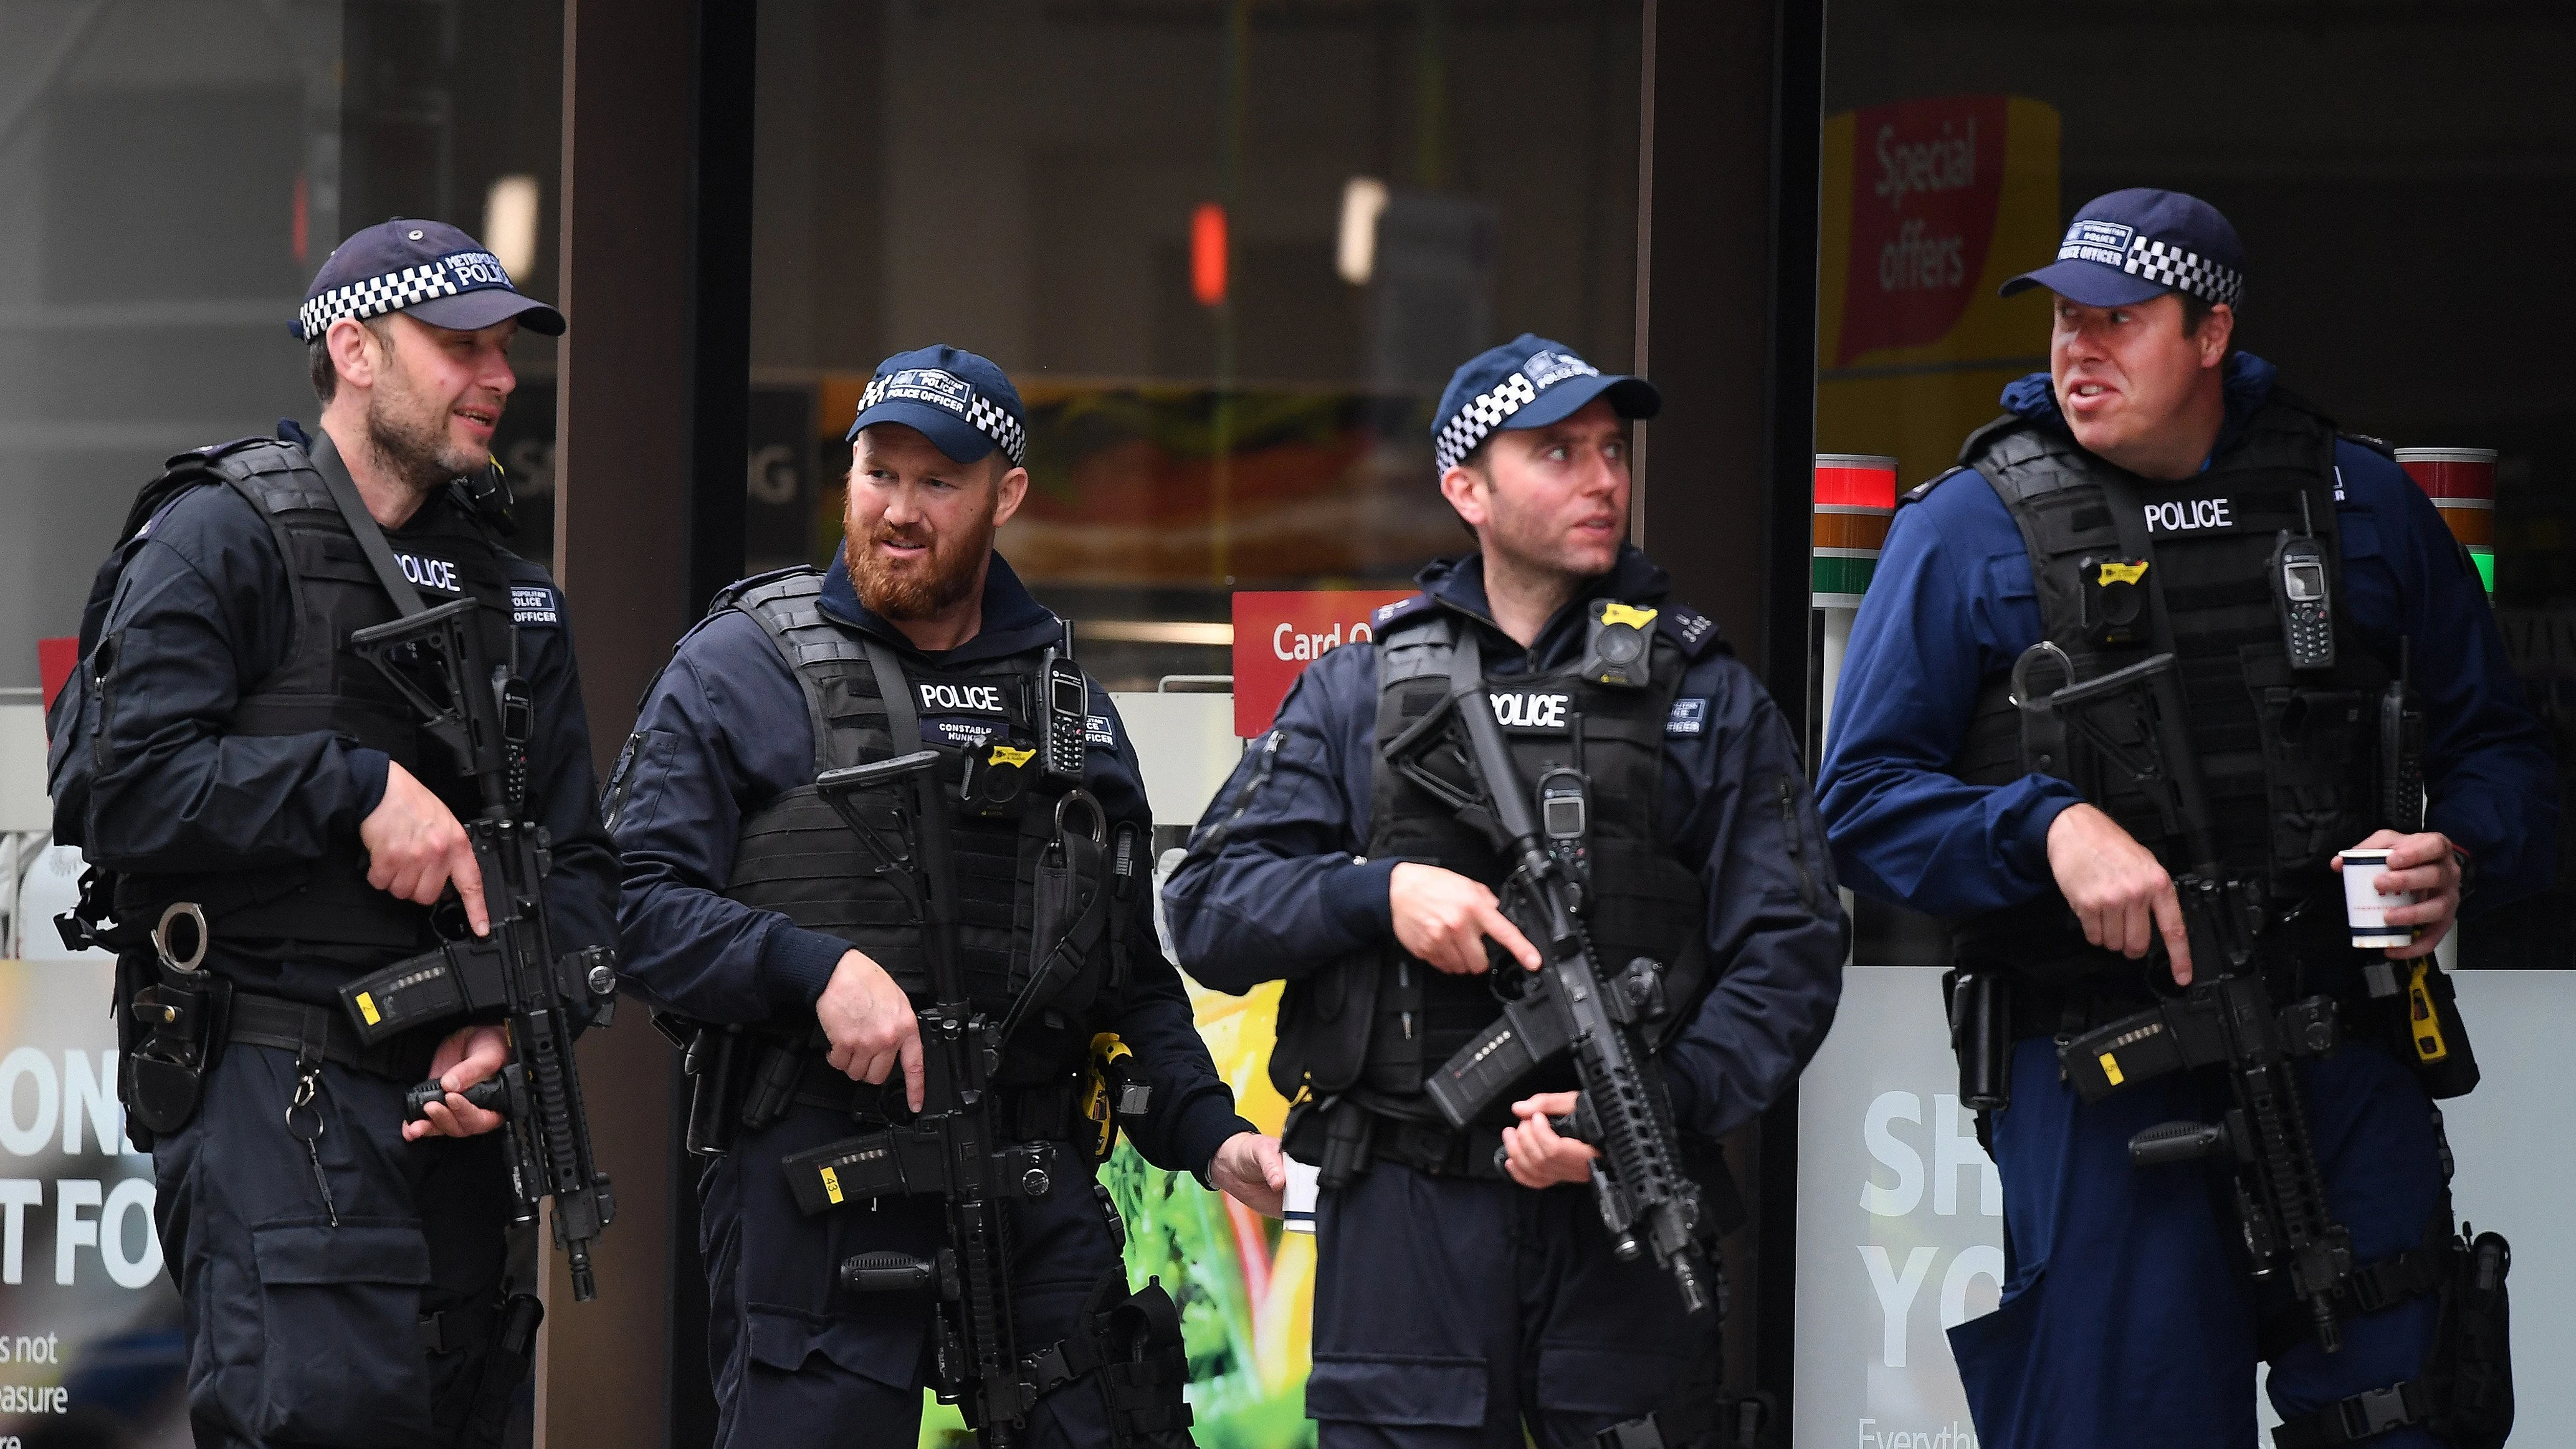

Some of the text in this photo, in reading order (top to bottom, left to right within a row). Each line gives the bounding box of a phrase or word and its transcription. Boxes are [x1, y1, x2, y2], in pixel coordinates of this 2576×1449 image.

[1874, 115, 1977, 210] Special
[2084, 232, 2117, 244] POLICE
[1879, 219, 1965, 291] offers
[2080, 246, 2123, 266] OFFICER
[921, 377, 956, 395] POLICE
[887, 388, 965, 413] POLICE OFFICER
[2144, 499, 2233, 533] POLICE
[512, 597, 542, 607] OLICE
[513, 611, 557, 623] OFFICER
[1273, 622, 1340, 661] Card
[920, 684, 1003, 711] POLICE
[938, 723, 992, 734] CONSTABLE
[948, 732, 974, 742] HUNK
[1085, 733, 1114, 745] FICER
[826, 1177, 838, 1192] 43
[16, 1331, 59, 1364] not
[0, 1385, 69, 1415] asure
